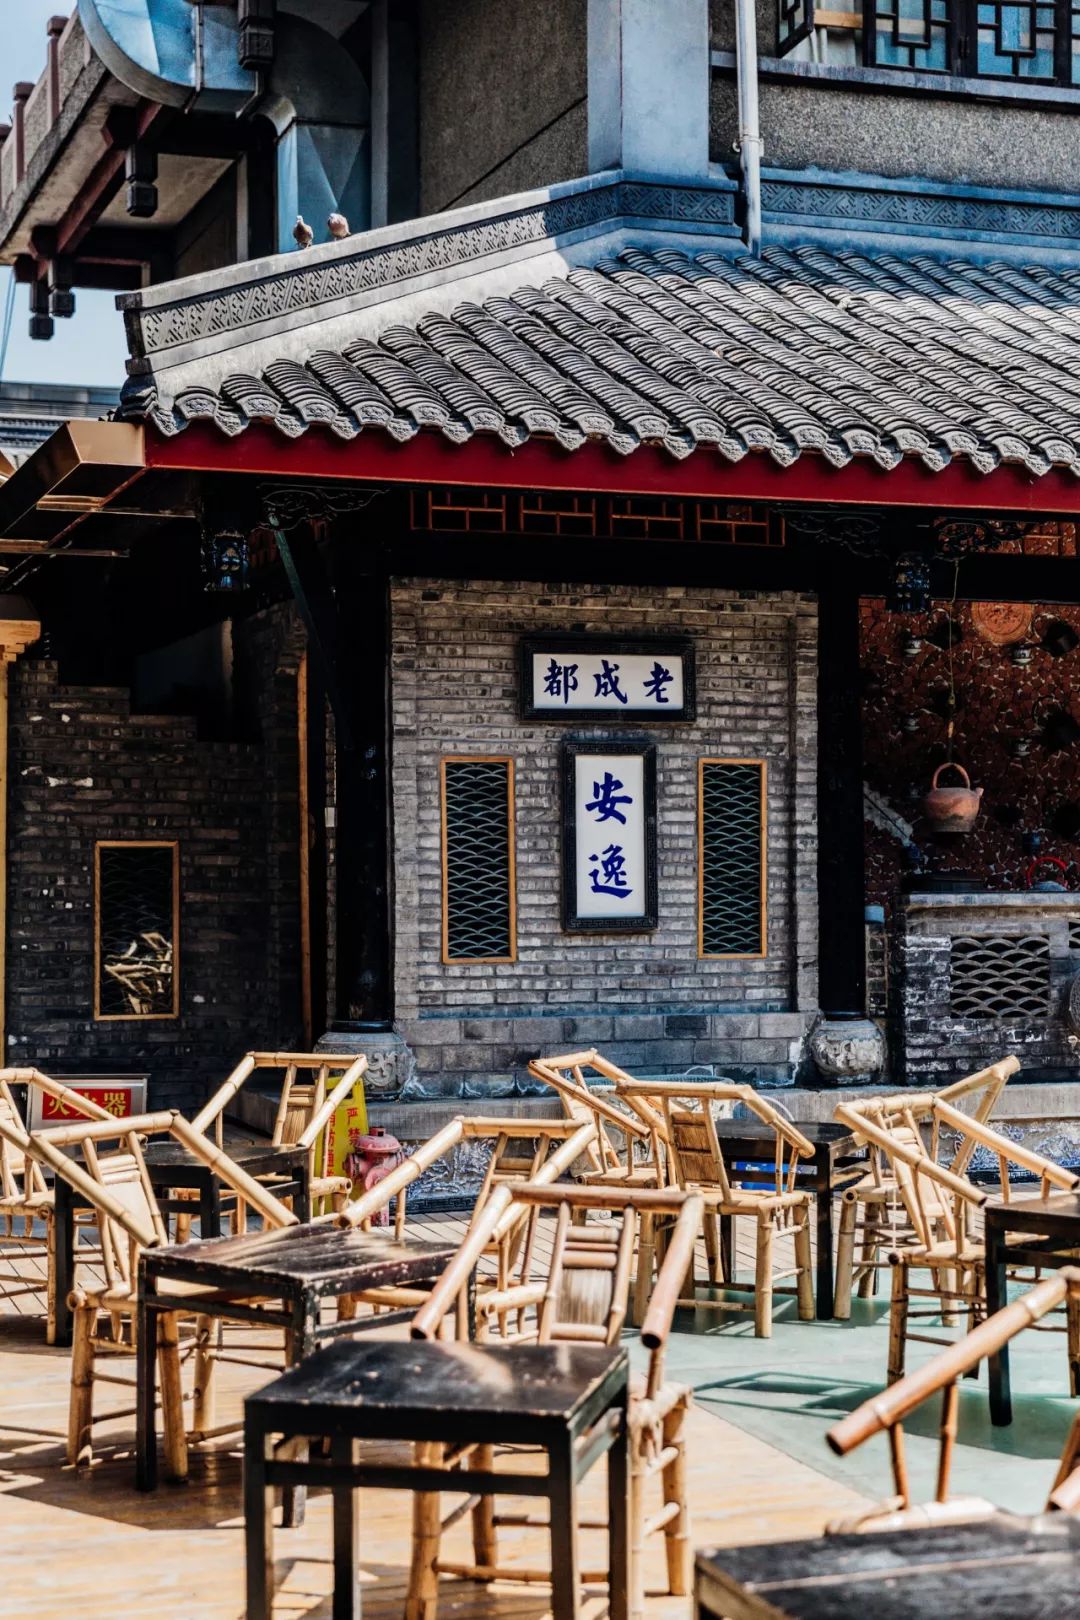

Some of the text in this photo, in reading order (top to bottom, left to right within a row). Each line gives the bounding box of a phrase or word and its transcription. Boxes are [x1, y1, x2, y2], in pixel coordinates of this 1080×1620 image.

[585, 772, 633, 899] 安逸
[47, 1092, 127, 1116] 灭器
[346, 1107, 361, 1146] 严禁
